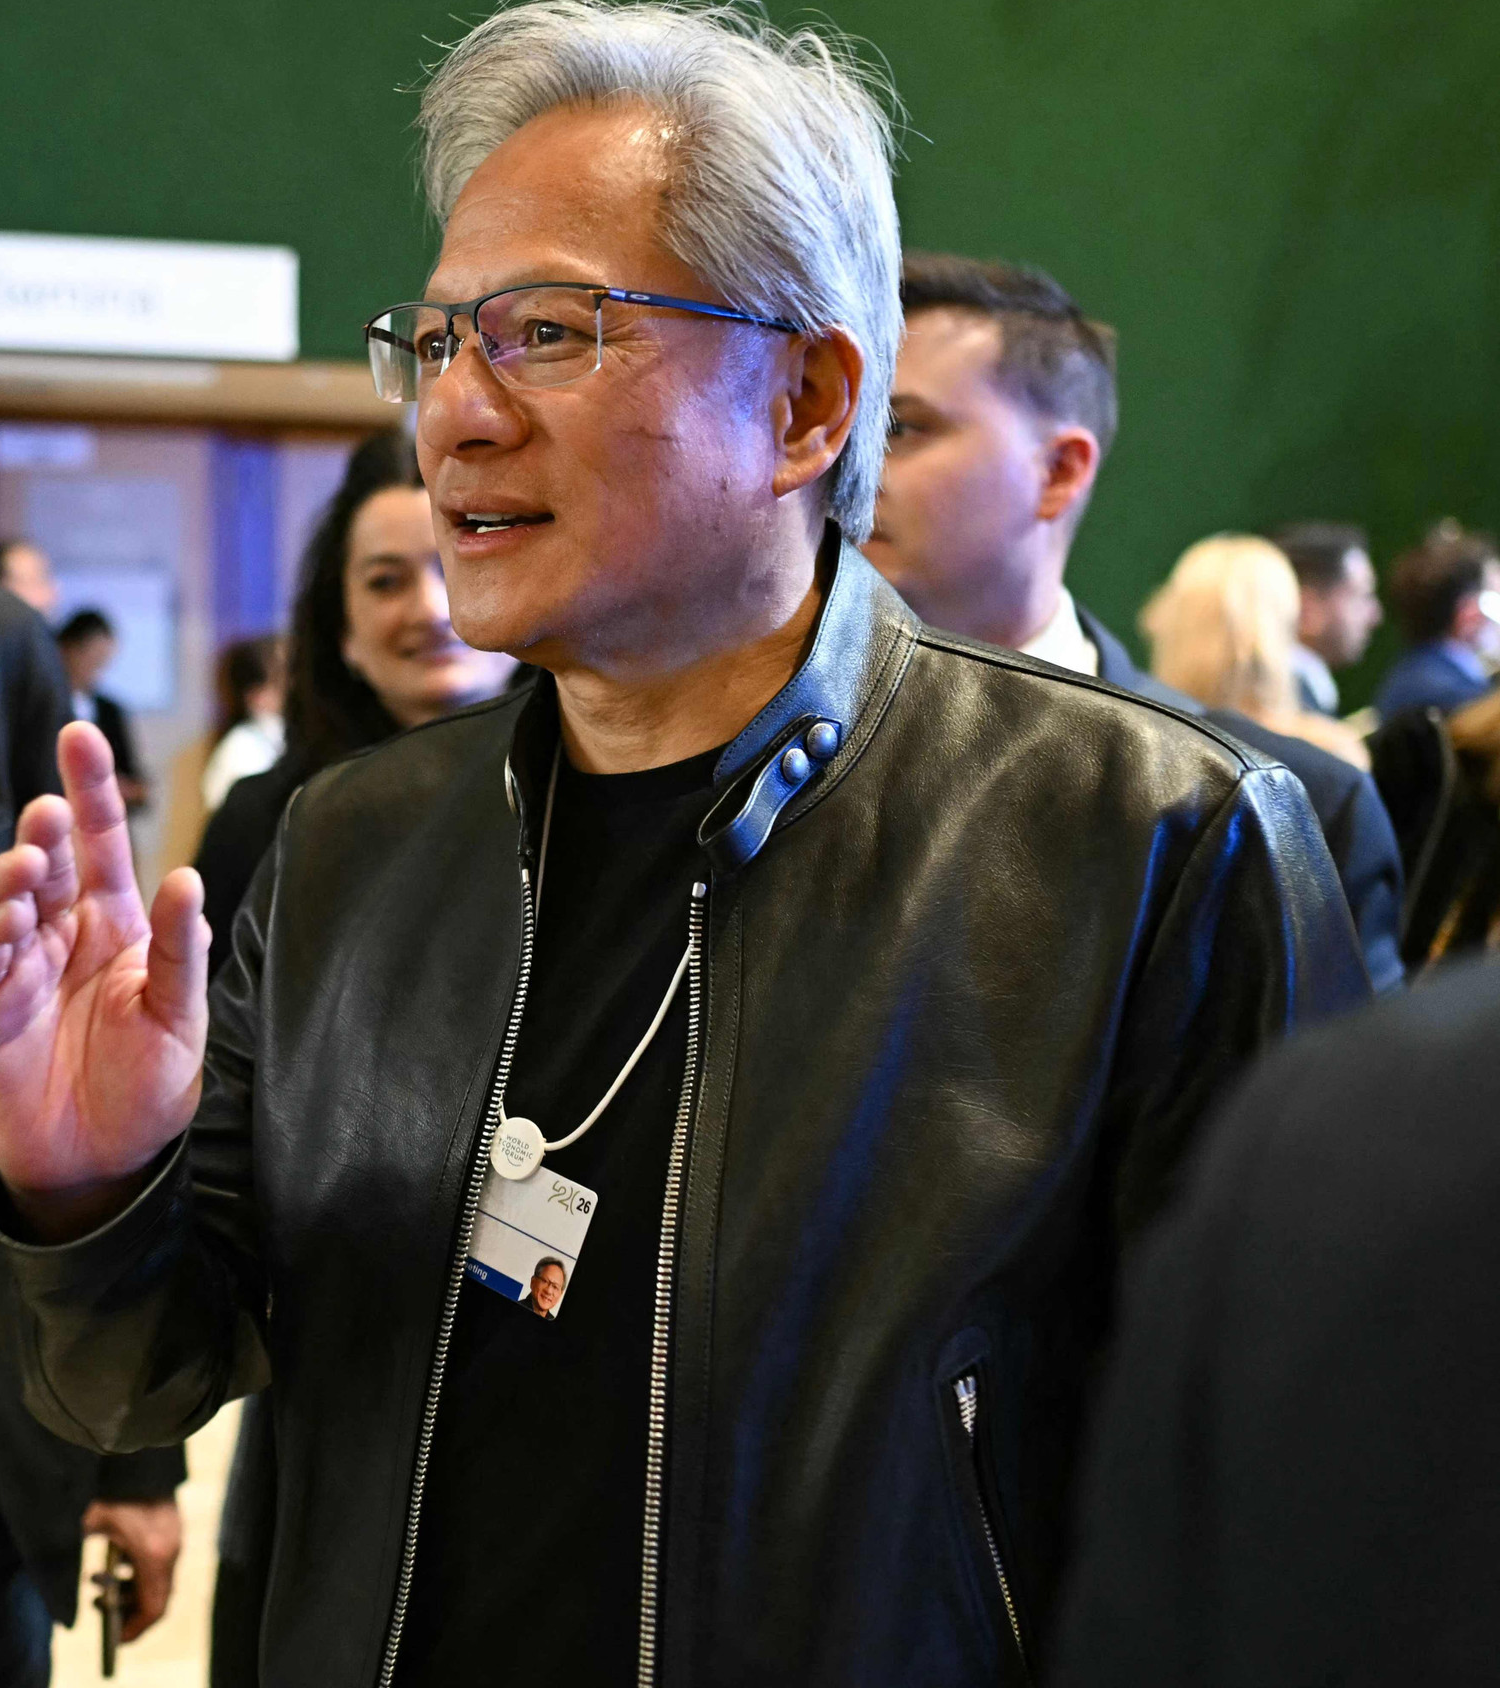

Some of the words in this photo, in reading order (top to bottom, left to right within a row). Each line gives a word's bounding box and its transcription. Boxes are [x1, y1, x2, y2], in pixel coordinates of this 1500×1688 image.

[506, 1135, 530, 1150] WORLD
[501, 1147, 524, 1163] FORUM
[576, 1197, 591, 1214] 26
